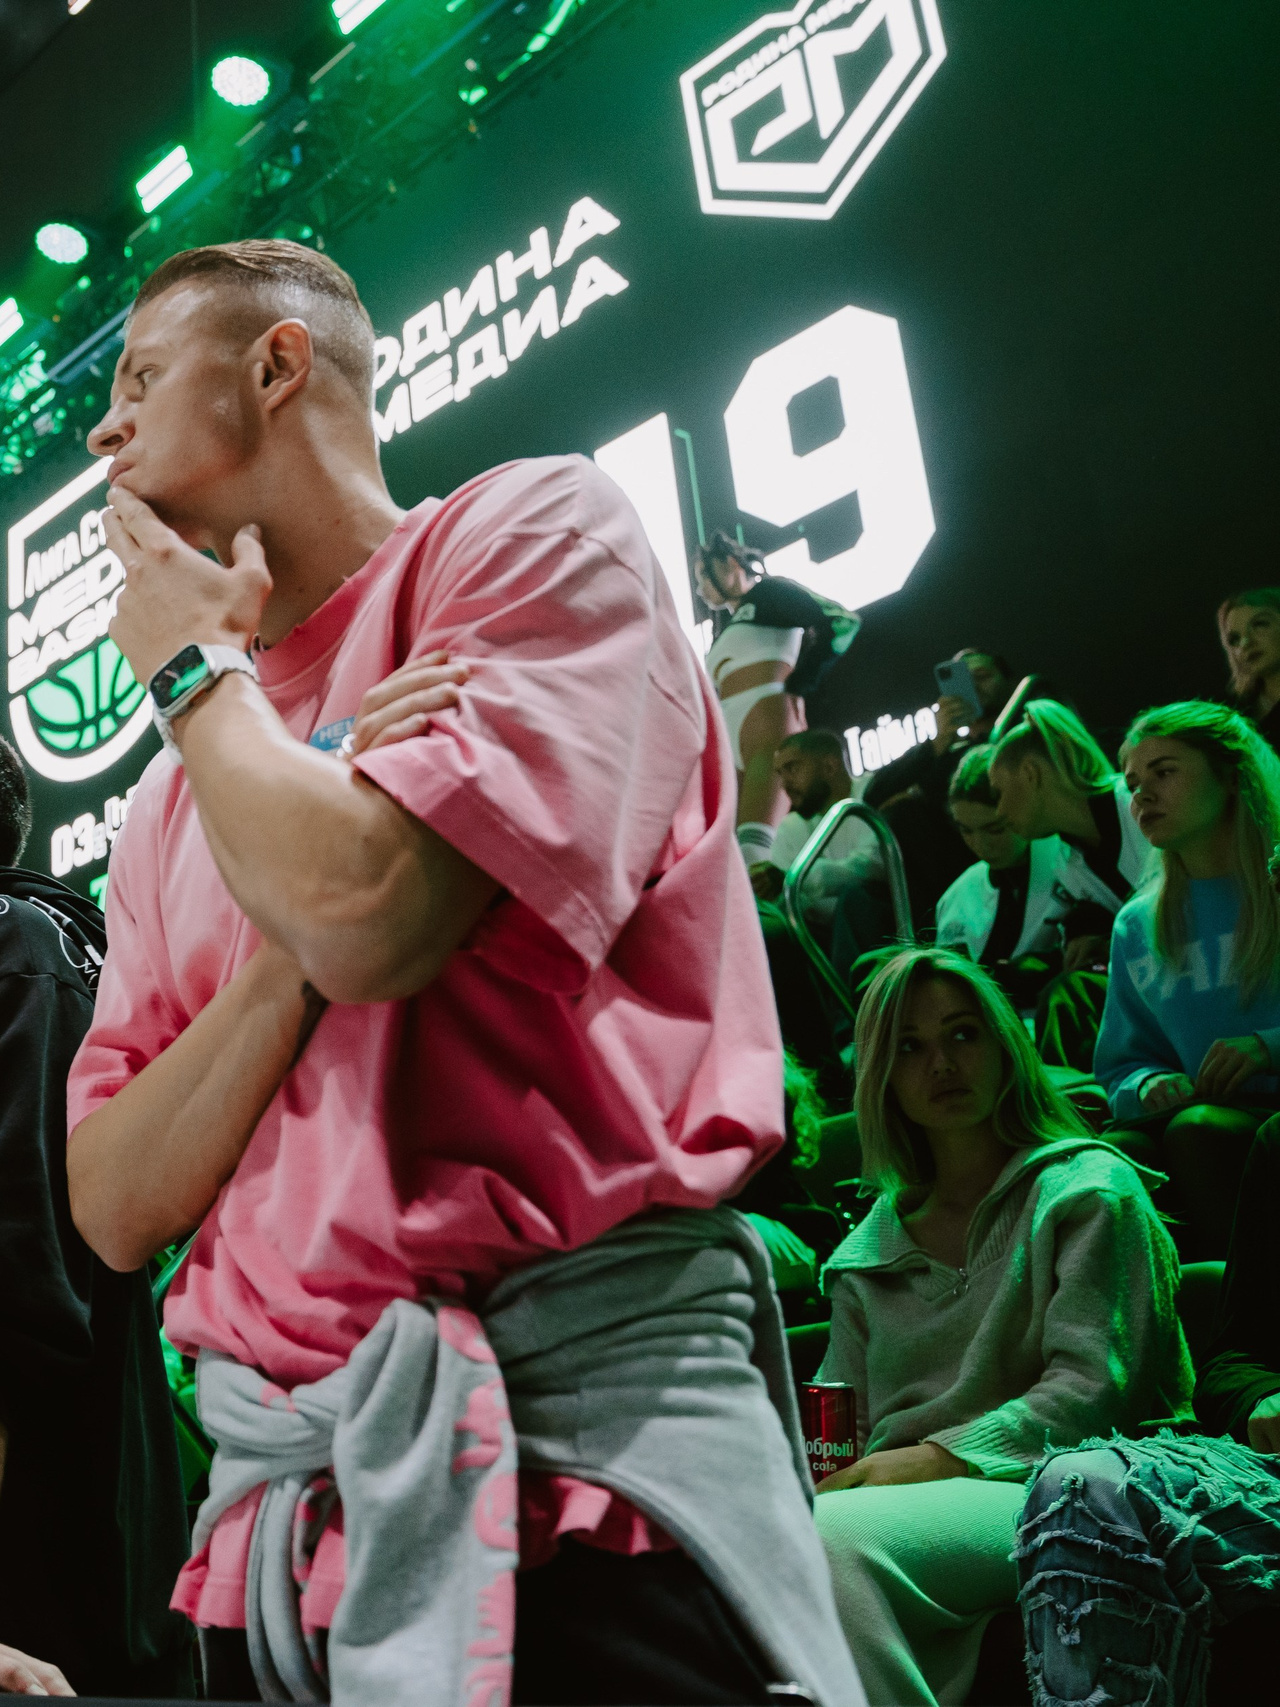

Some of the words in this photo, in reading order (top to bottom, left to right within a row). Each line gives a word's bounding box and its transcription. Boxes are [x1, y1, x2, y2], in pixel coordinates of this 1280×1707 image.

[372, 196, 621, 390] ОДИНА
[8, 548, 127, 658] MED
[843, 702, 940, 777] Тайма
[805, 1437, 854, 1459] обрый
[812, 1461, 838, 1472] cola
